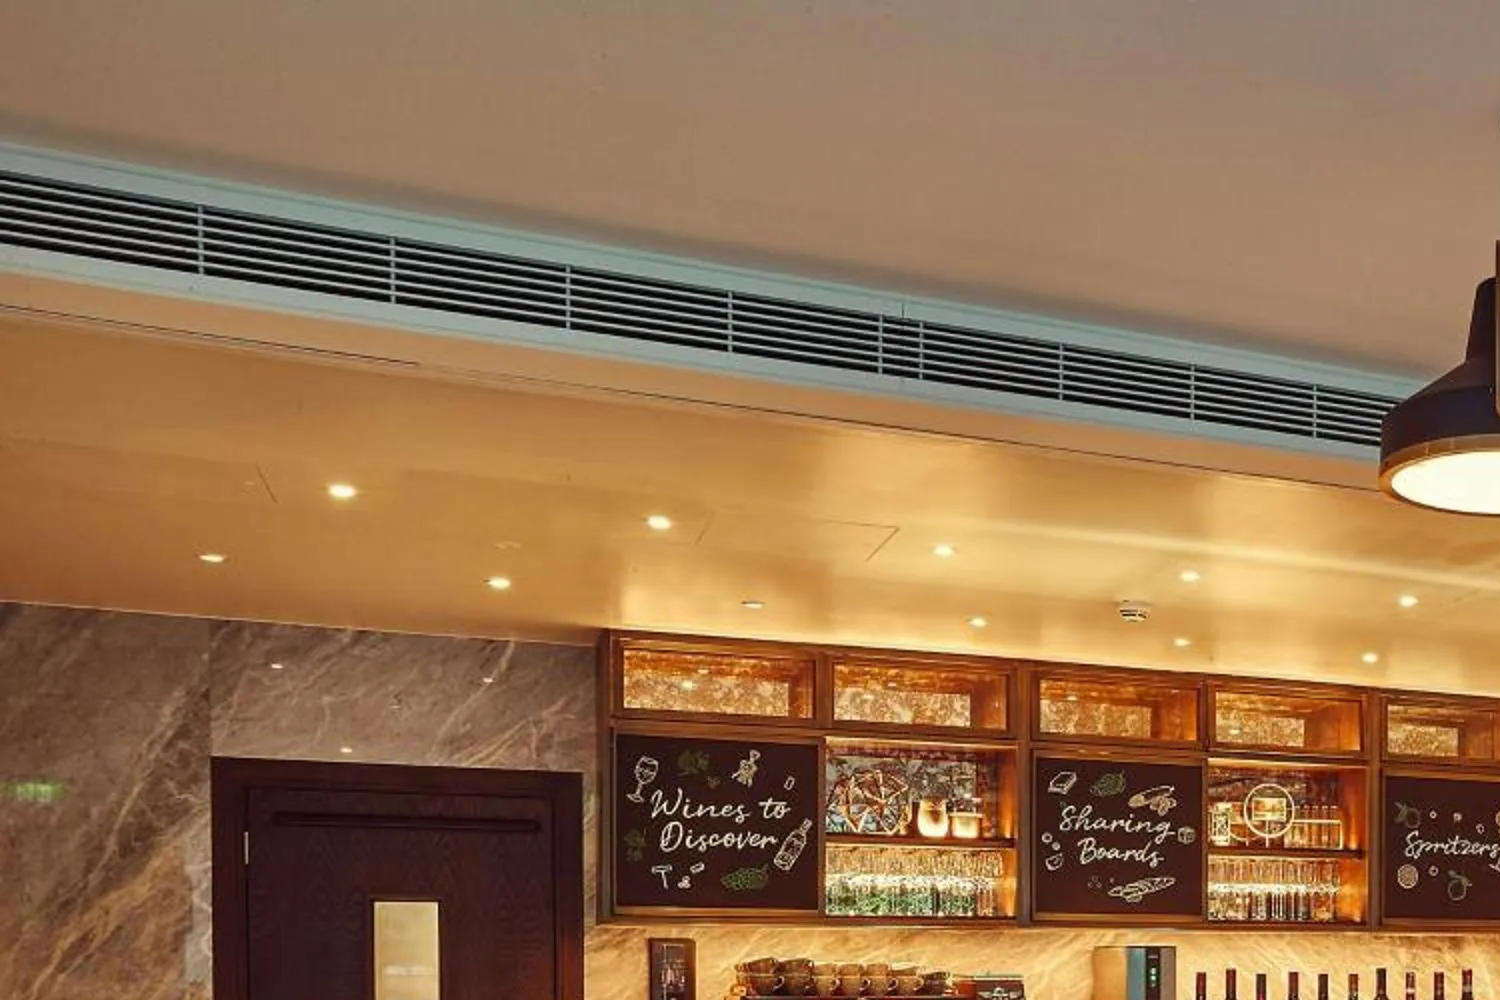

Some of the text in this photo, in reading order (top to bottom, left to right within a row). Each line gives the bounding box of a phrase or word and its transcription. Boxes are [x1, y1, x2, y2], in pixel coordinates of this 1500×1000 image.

[650, 787, 791, 824] Wines to
[659, 821, 778, 852] Discover
[1059, 804, 1176, 844] Sharing
[1077, 837, 1165, 868] Boards
